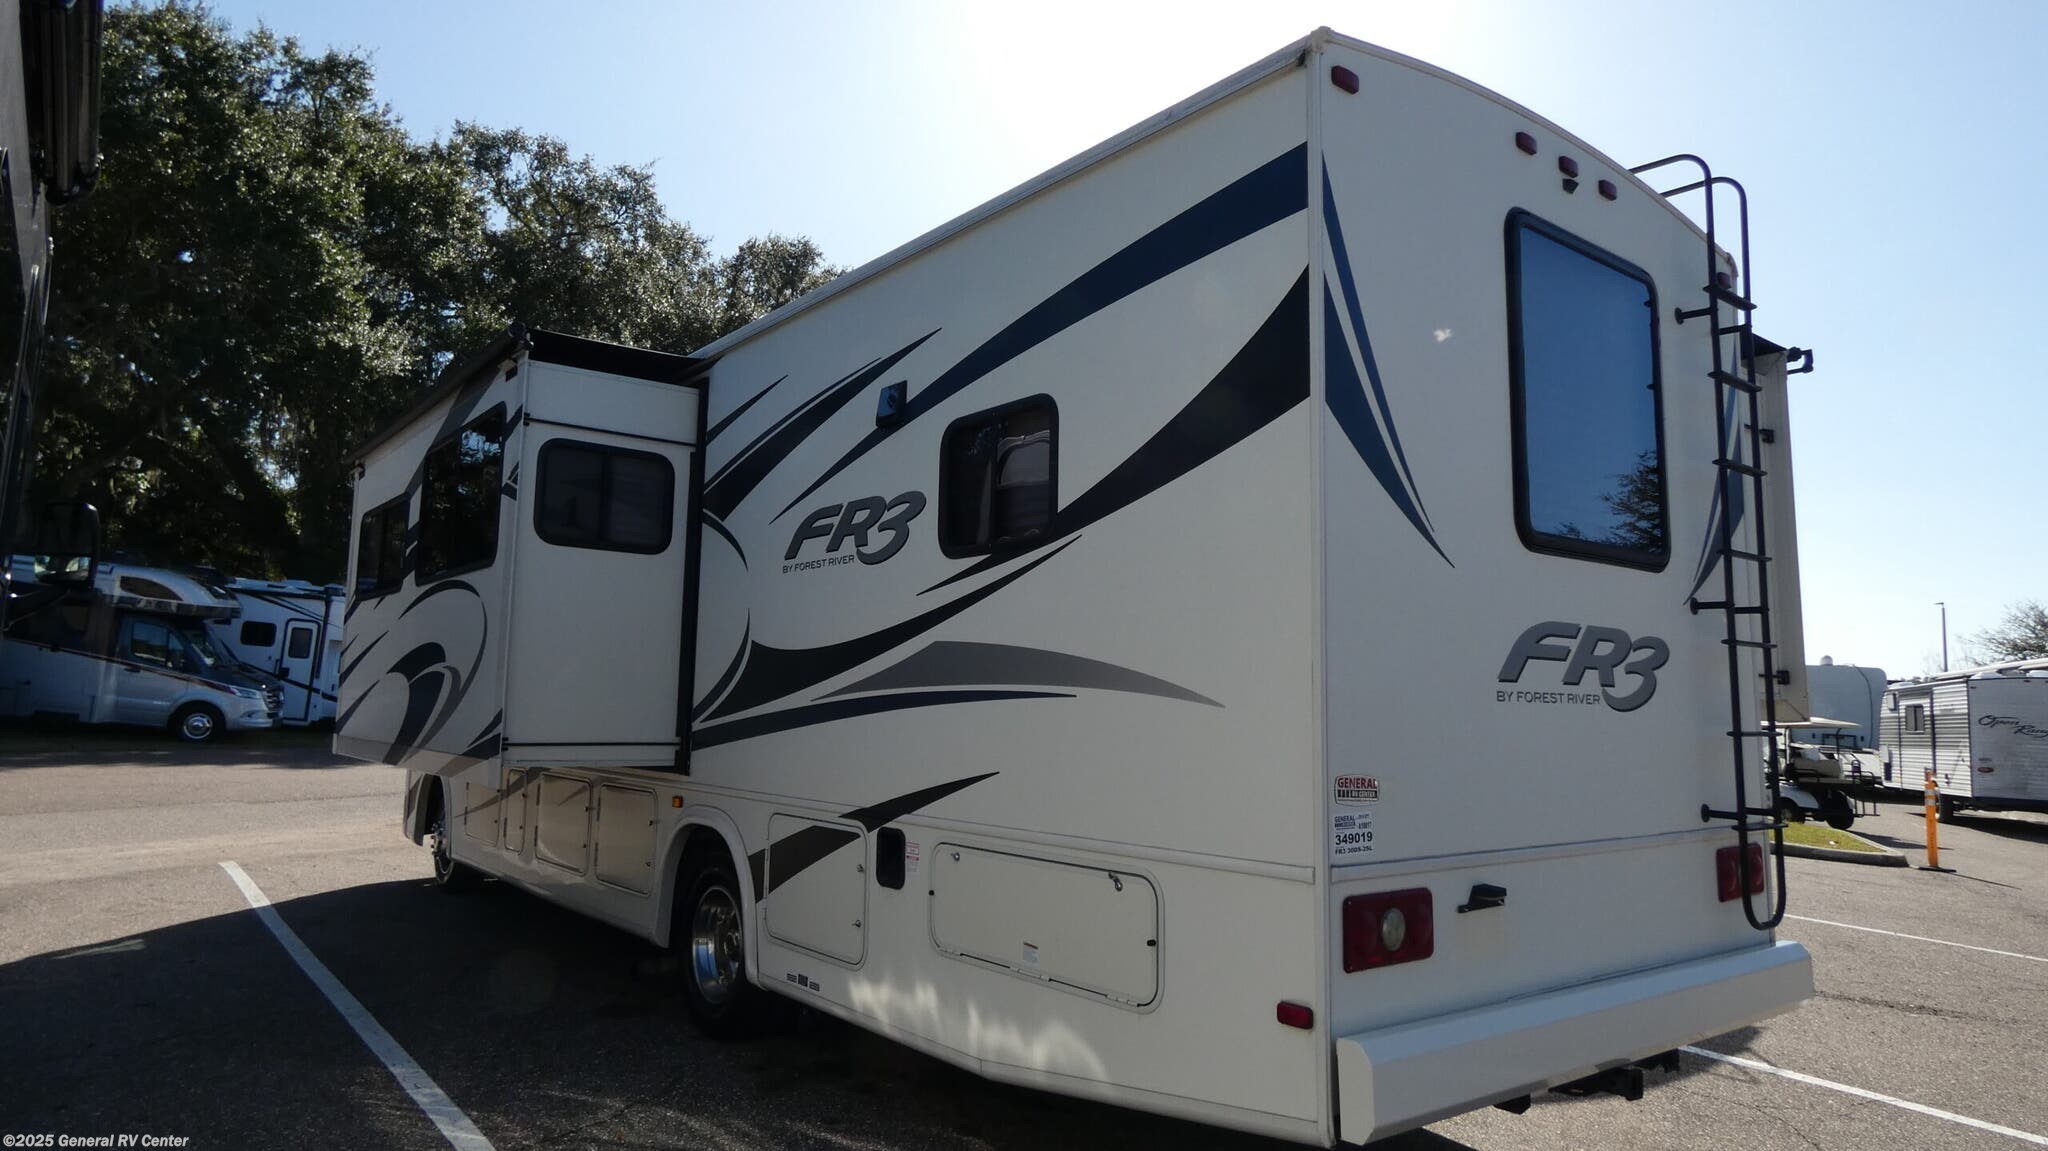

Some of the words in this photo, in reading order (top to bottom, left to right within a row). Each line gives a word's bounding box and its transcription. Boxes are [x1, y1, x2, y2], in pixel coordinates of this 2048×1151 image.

[783, 490, 927, 565] FR3
[782, 564, 793, 574] BY
[794, 558, 827, 572] FOREST
[828, 554, 856, 567] RIVER
[1497, 620, 1670, 712] FR3
[1496, 690, 1513, 702] BY
[1516, 691, 1565, 704] FOREST
[1566, 693, 1601, 705] RIVER
[1337, 777, 1378, 789] GENERAL
[1335, 831, 1373, 845] 349019
